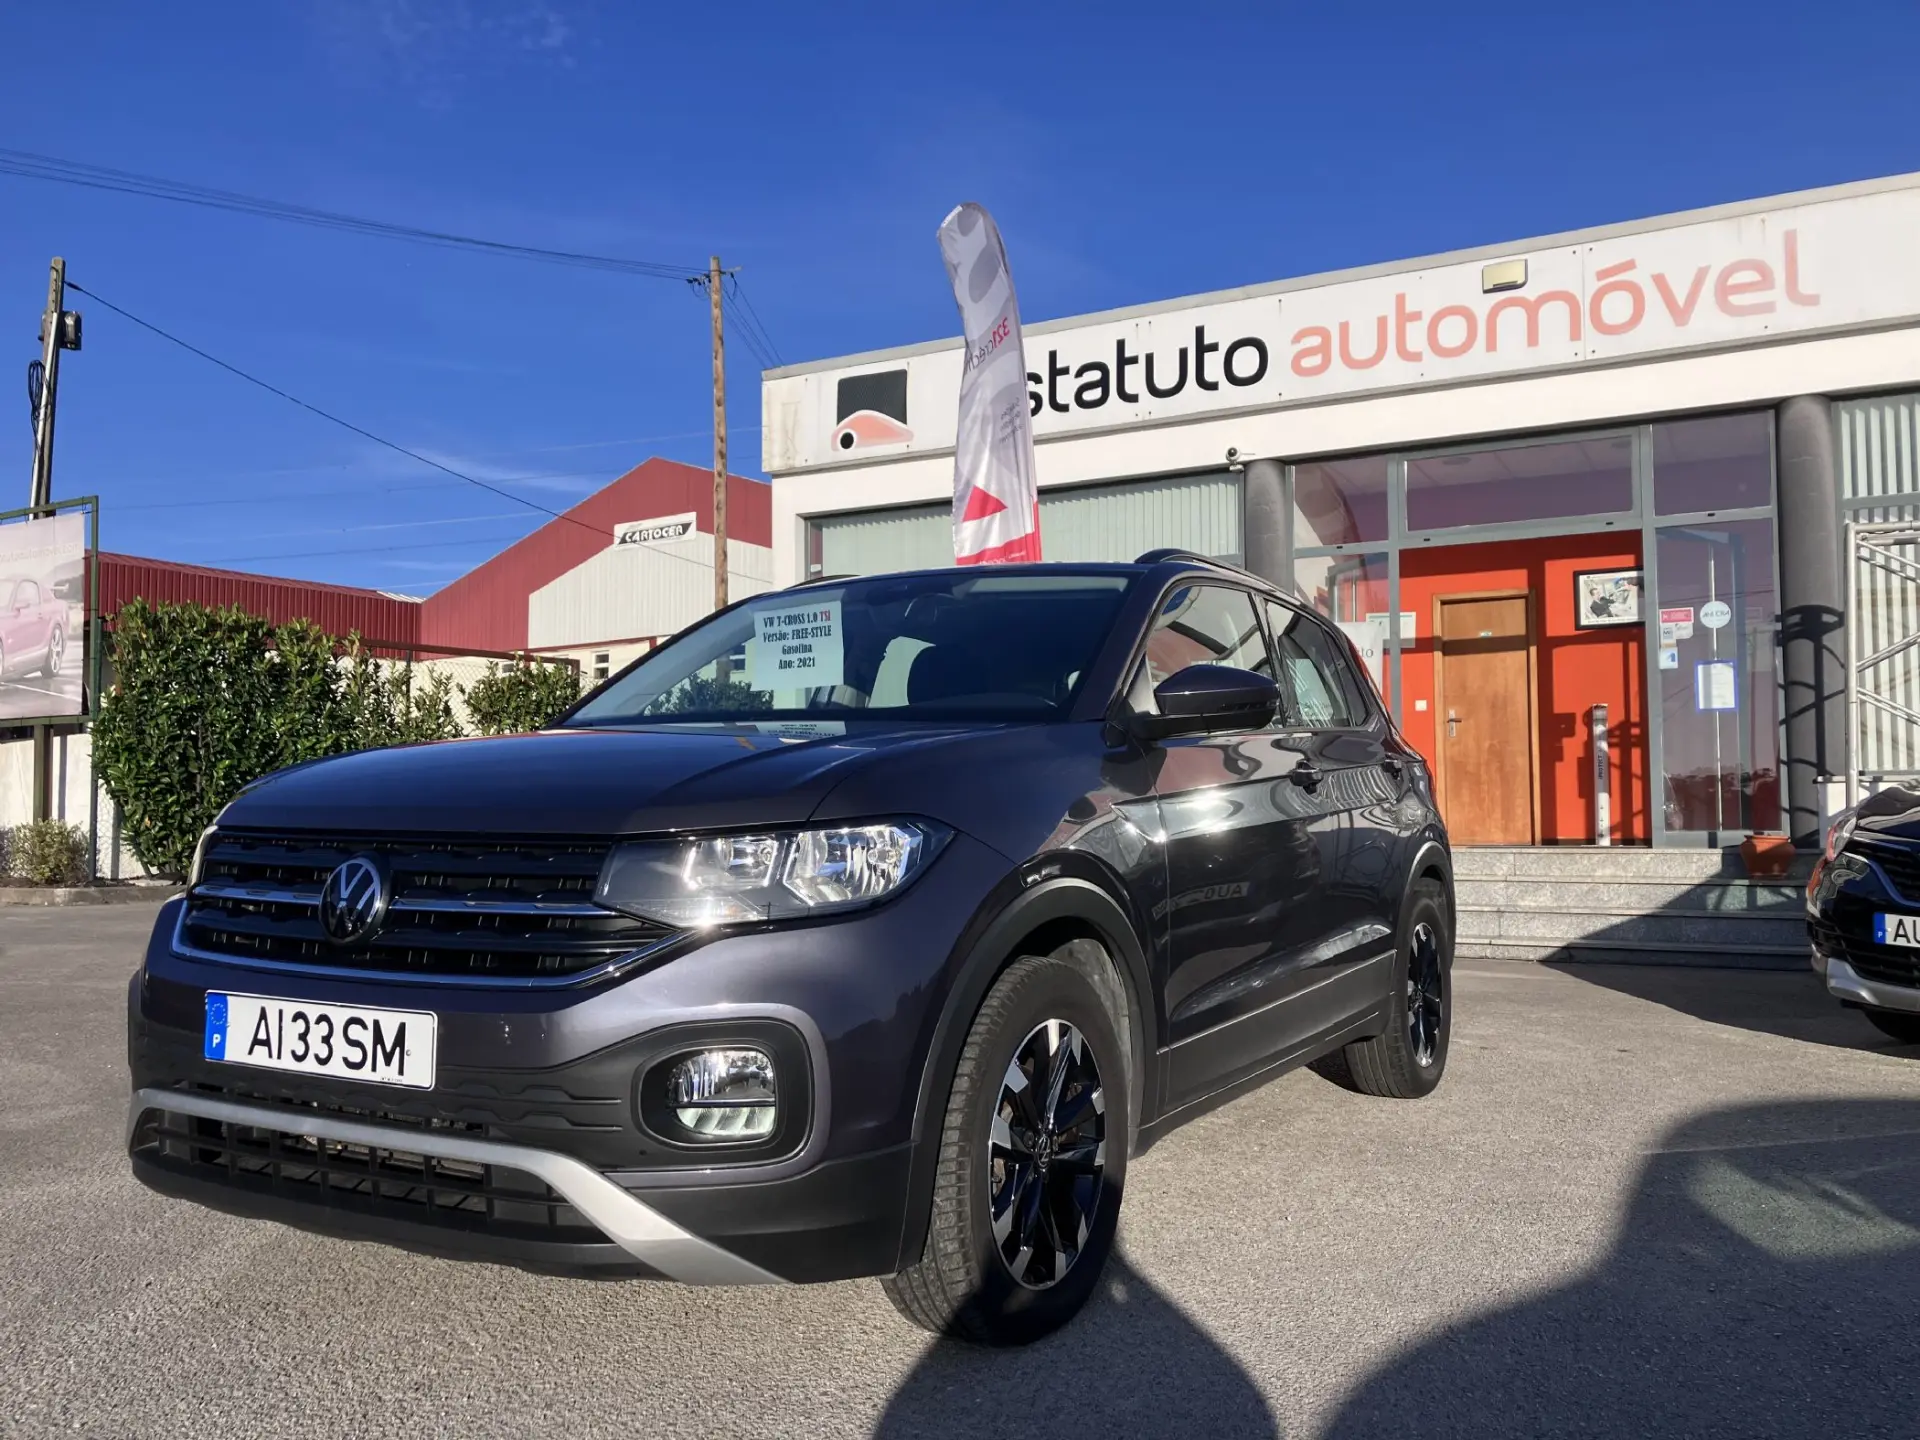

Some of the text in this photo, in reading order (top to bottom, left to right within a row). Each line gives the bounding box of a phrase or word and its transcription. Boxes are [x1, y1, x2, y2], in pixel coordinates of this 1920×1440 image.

[1290, 227, 1821, 378] automóvel
[763, 609, 831, 628] VW T-CROSS 1.0 TSI
[763, 625, 832, 643] Versão: FREE-STYLE
[782, 643, 813, 655] Gasolina
[778, 656, 816, 670] Ano: 2021
